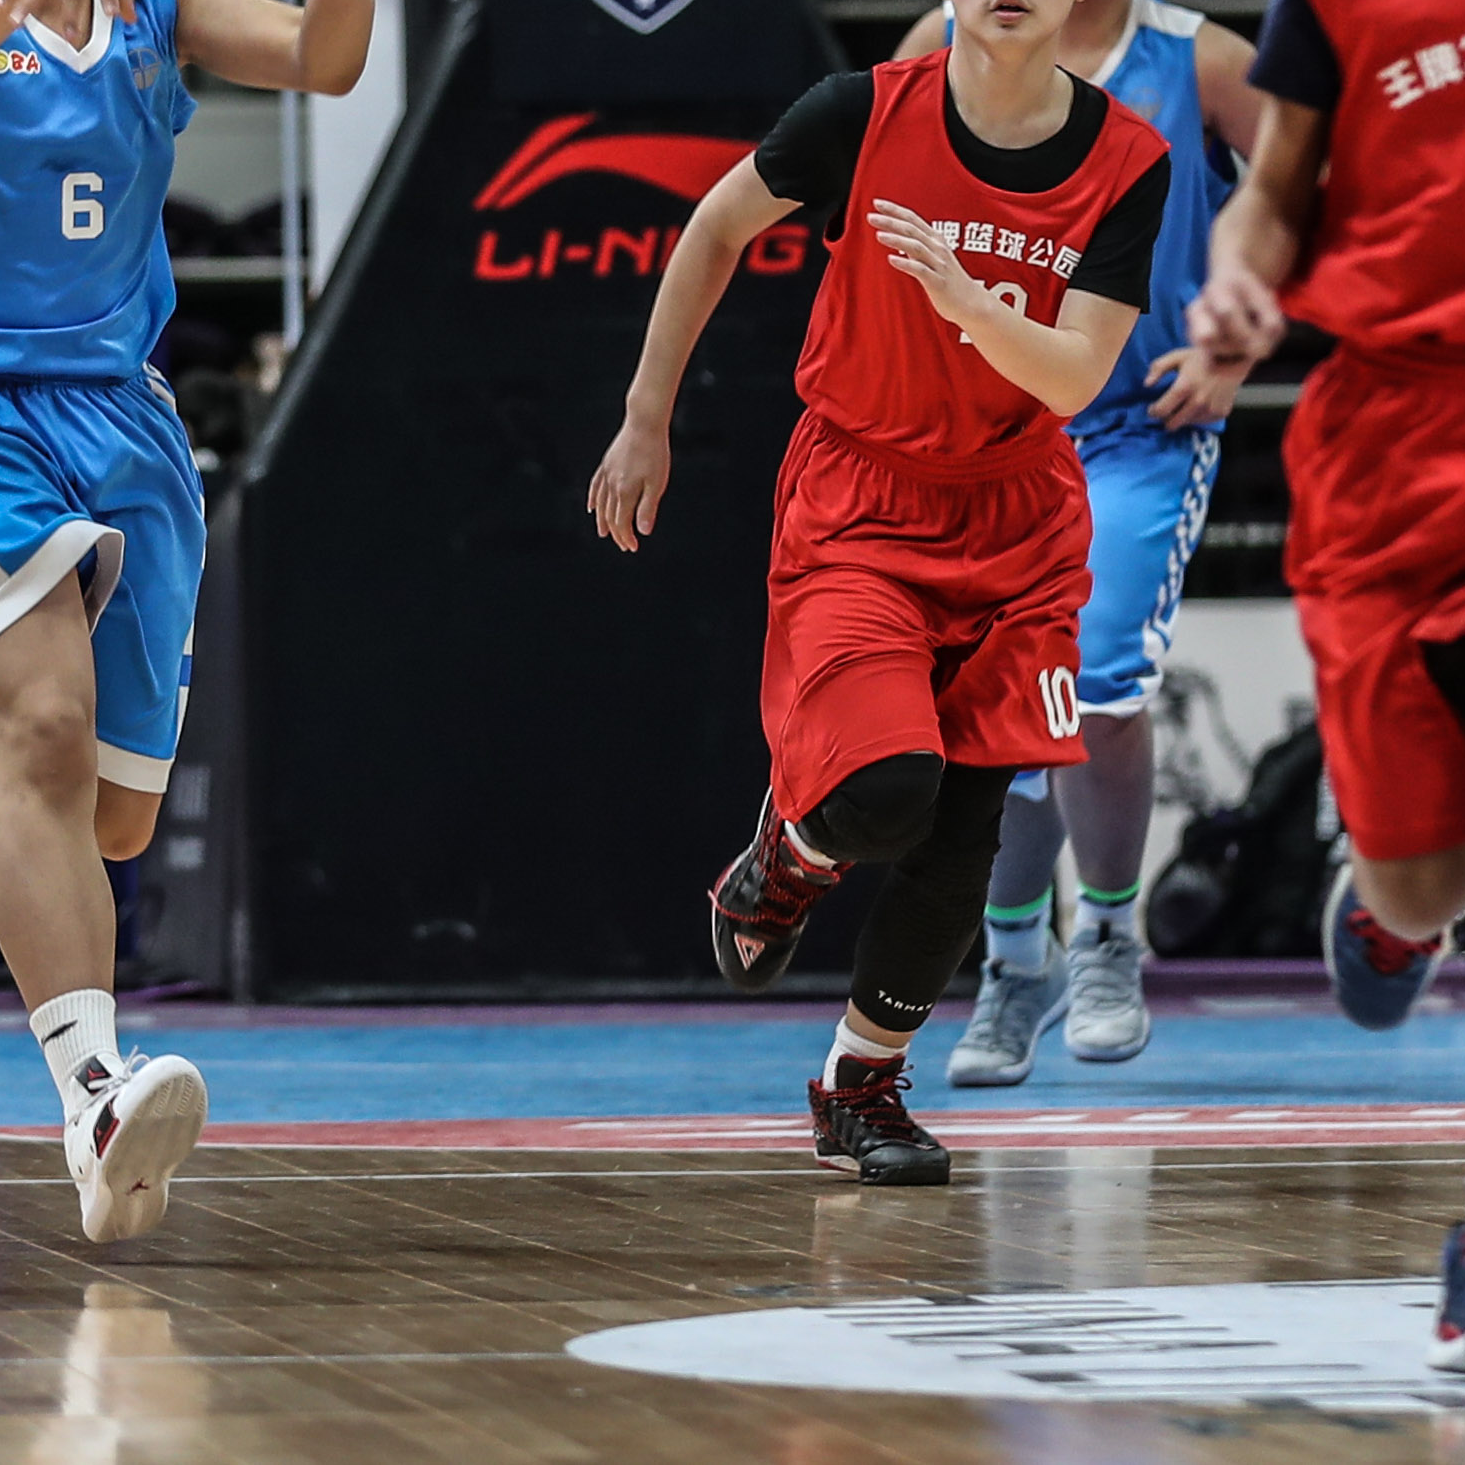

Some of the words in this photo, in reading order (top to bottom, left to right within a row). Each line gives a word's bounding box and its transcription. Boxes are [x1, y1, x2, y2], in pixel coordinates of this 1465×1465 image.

[61, 171, 105, 241] 6
[475, 225, 812, 280] LI-NIG
[899, 220, 1083, 281] 牌篮球公园
[1038, 665, 1082, 740] 10
